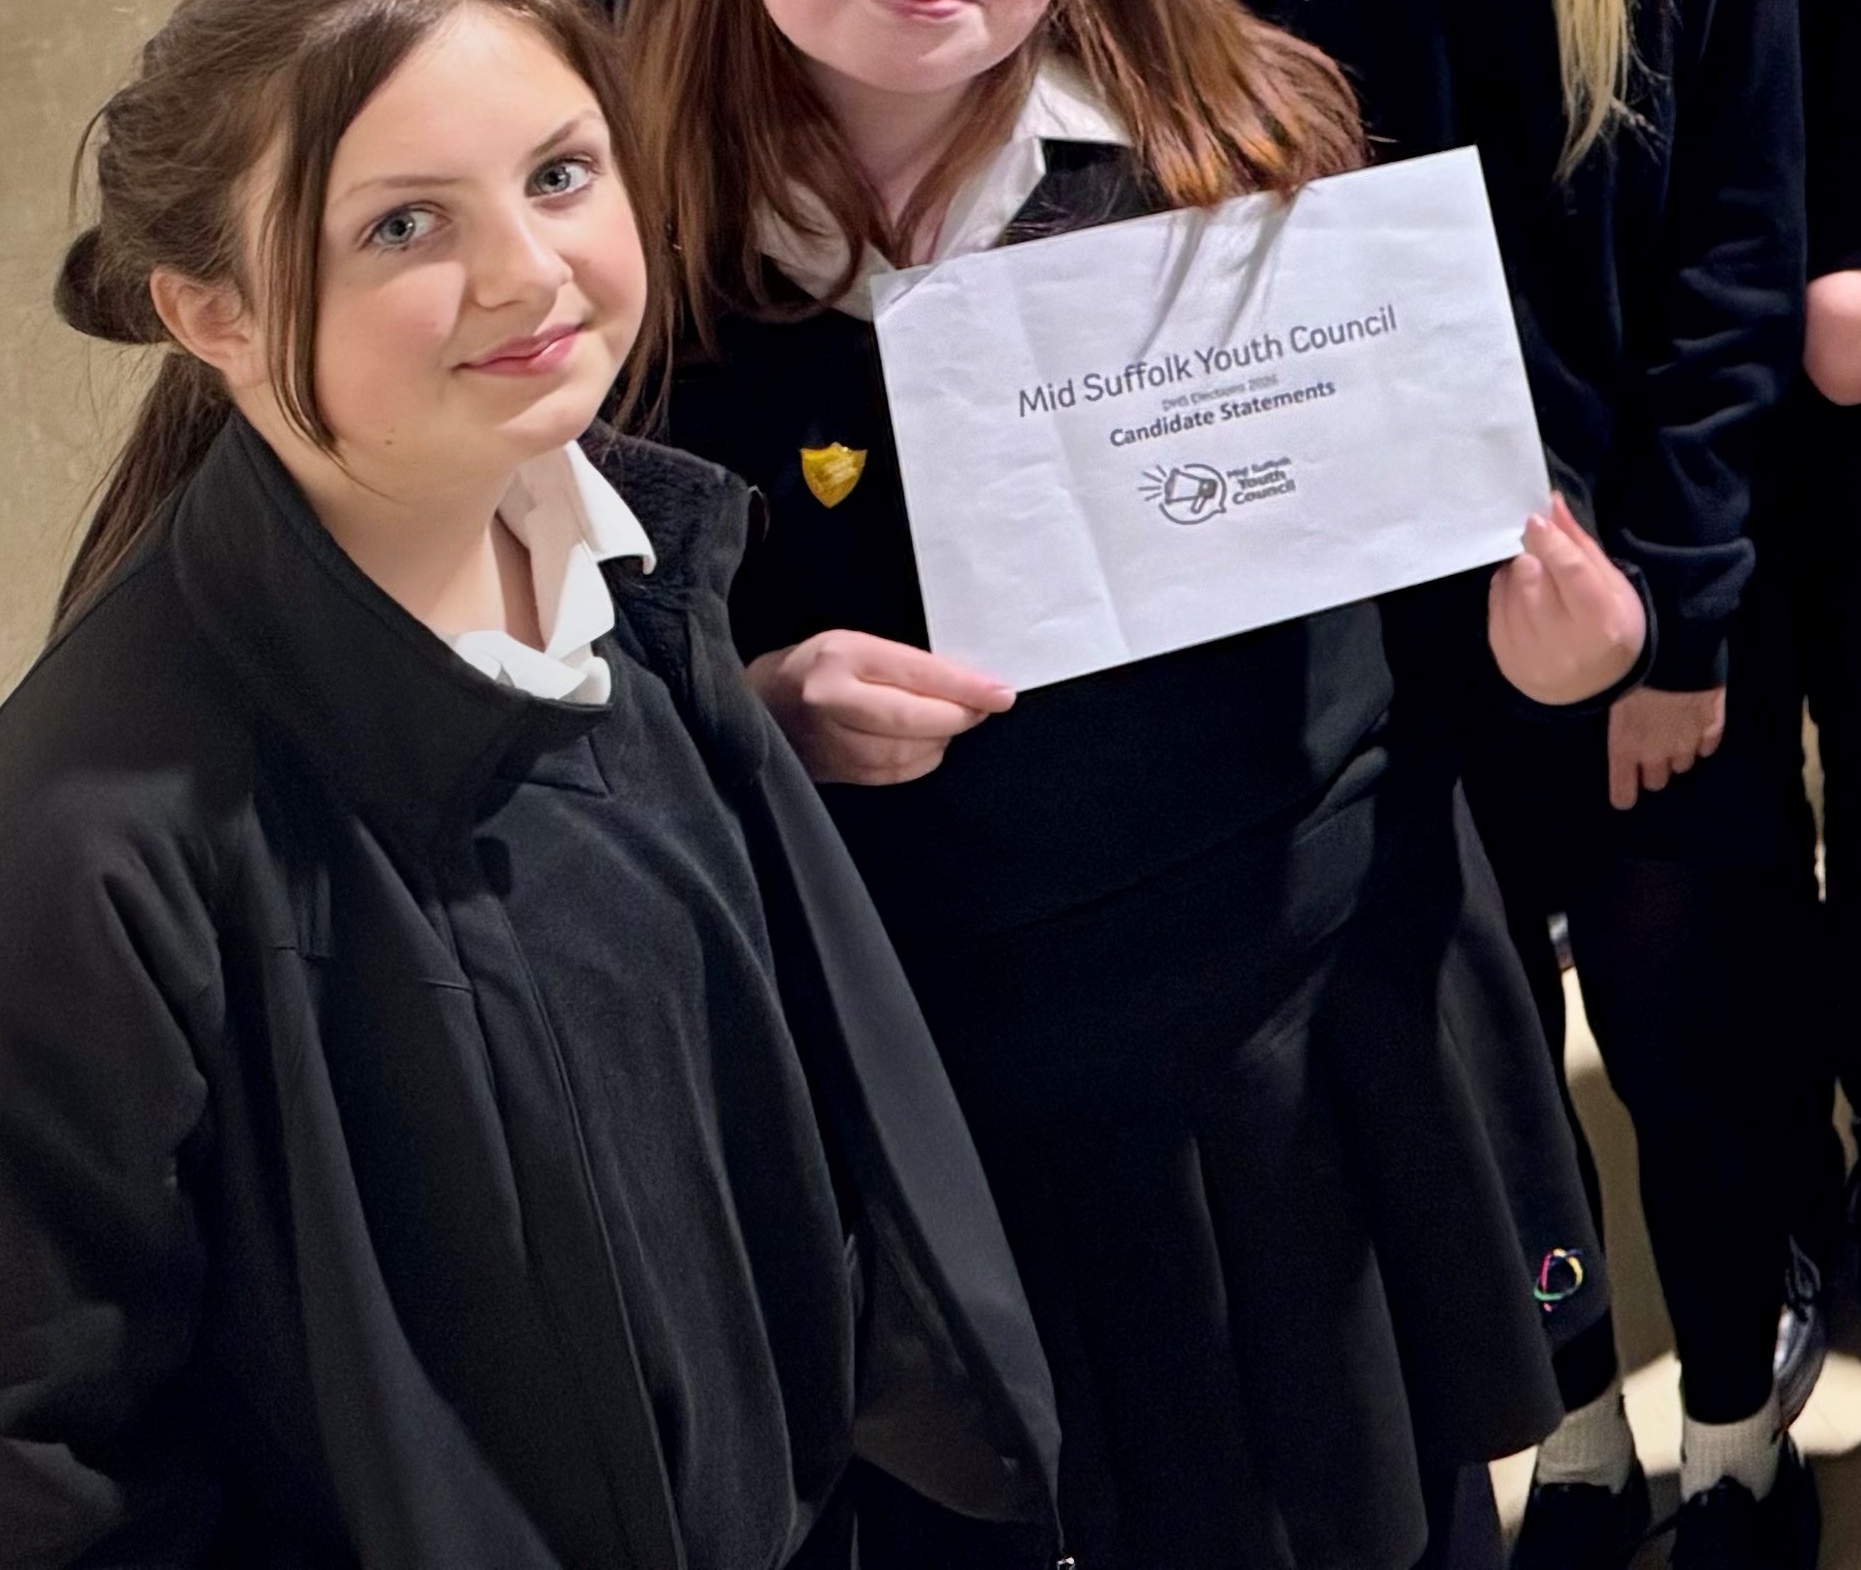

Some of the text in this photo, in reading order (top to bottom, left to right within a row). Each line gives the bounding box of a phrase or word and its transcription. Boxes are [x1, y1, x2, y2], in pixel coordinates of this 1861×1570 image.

[1018, 303, 1398, 418] Mid Suffolk Youth Council
[1109, 379, 1336, 449] Candidate Statements
[1231, 478, 1297, 506] Council
[1237, 469, 1287, 490] Youth
